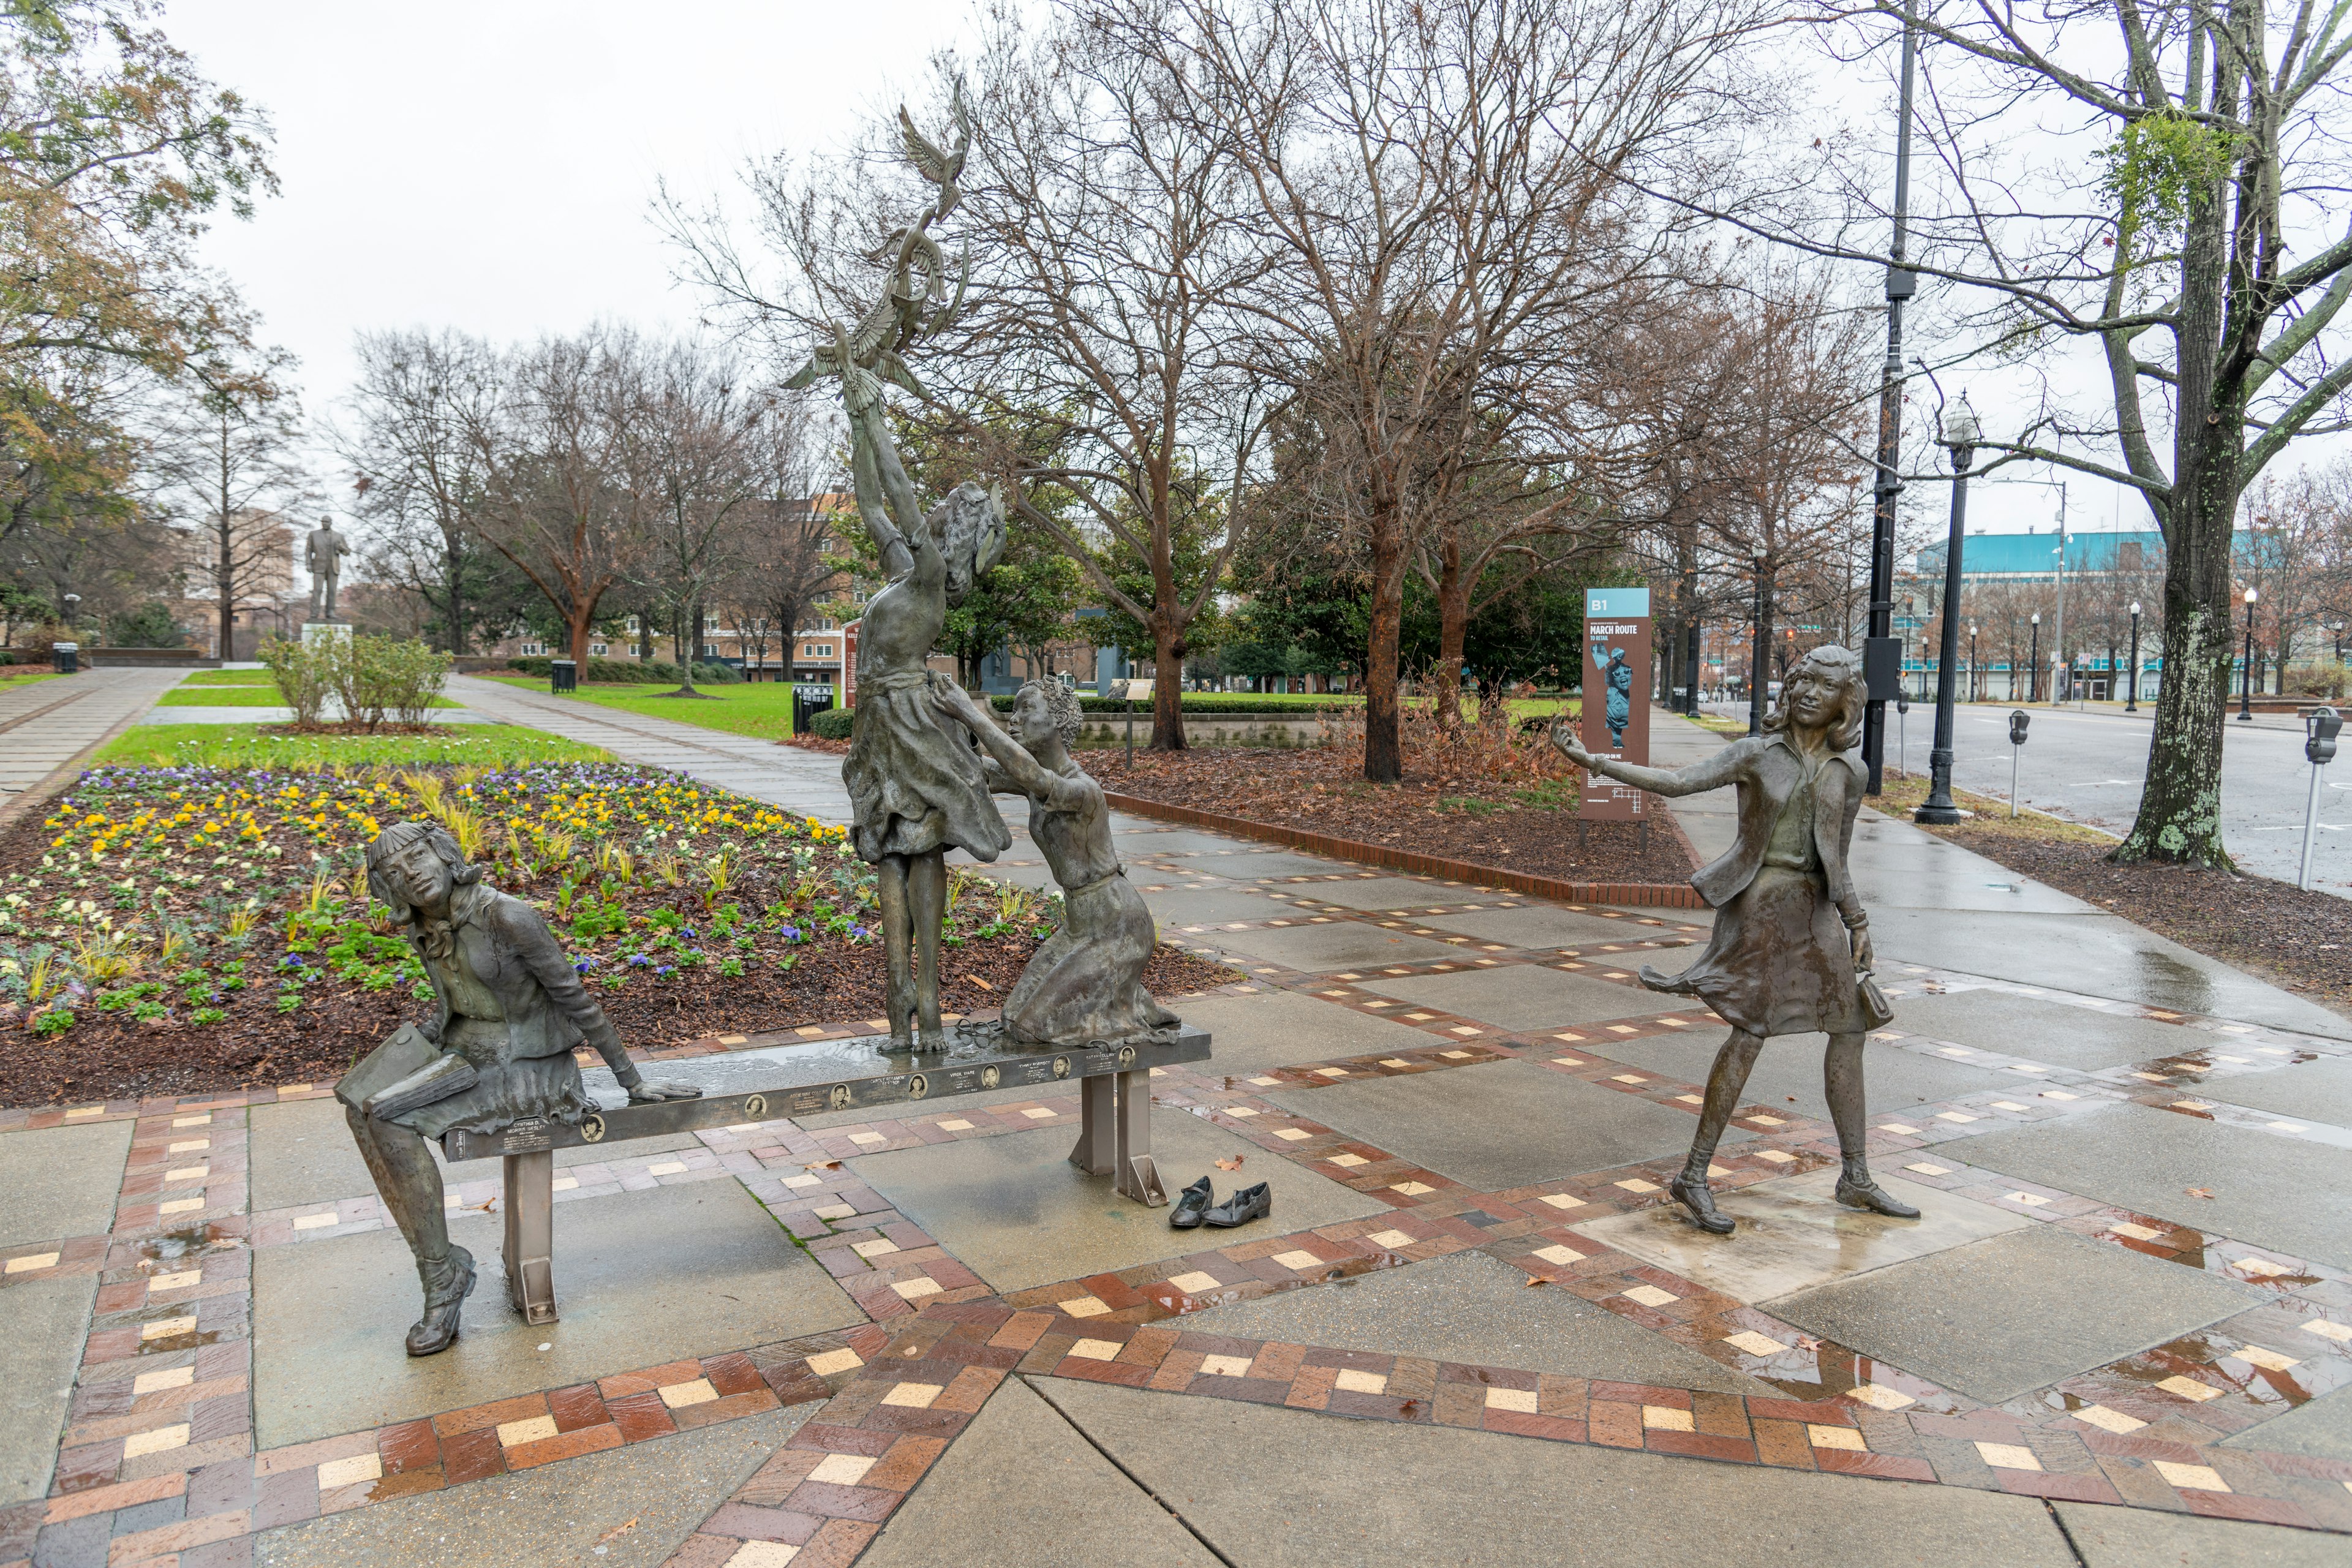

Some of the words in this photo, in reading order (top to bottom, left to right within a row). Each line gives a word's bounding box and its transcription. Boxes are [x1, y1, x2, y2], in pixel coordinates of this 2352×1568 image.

[1592, 600, 1607, 611] B1
[1590, 625, 1614, 635] MARCH
[1615, 625, 1637, 635] ROUTE
